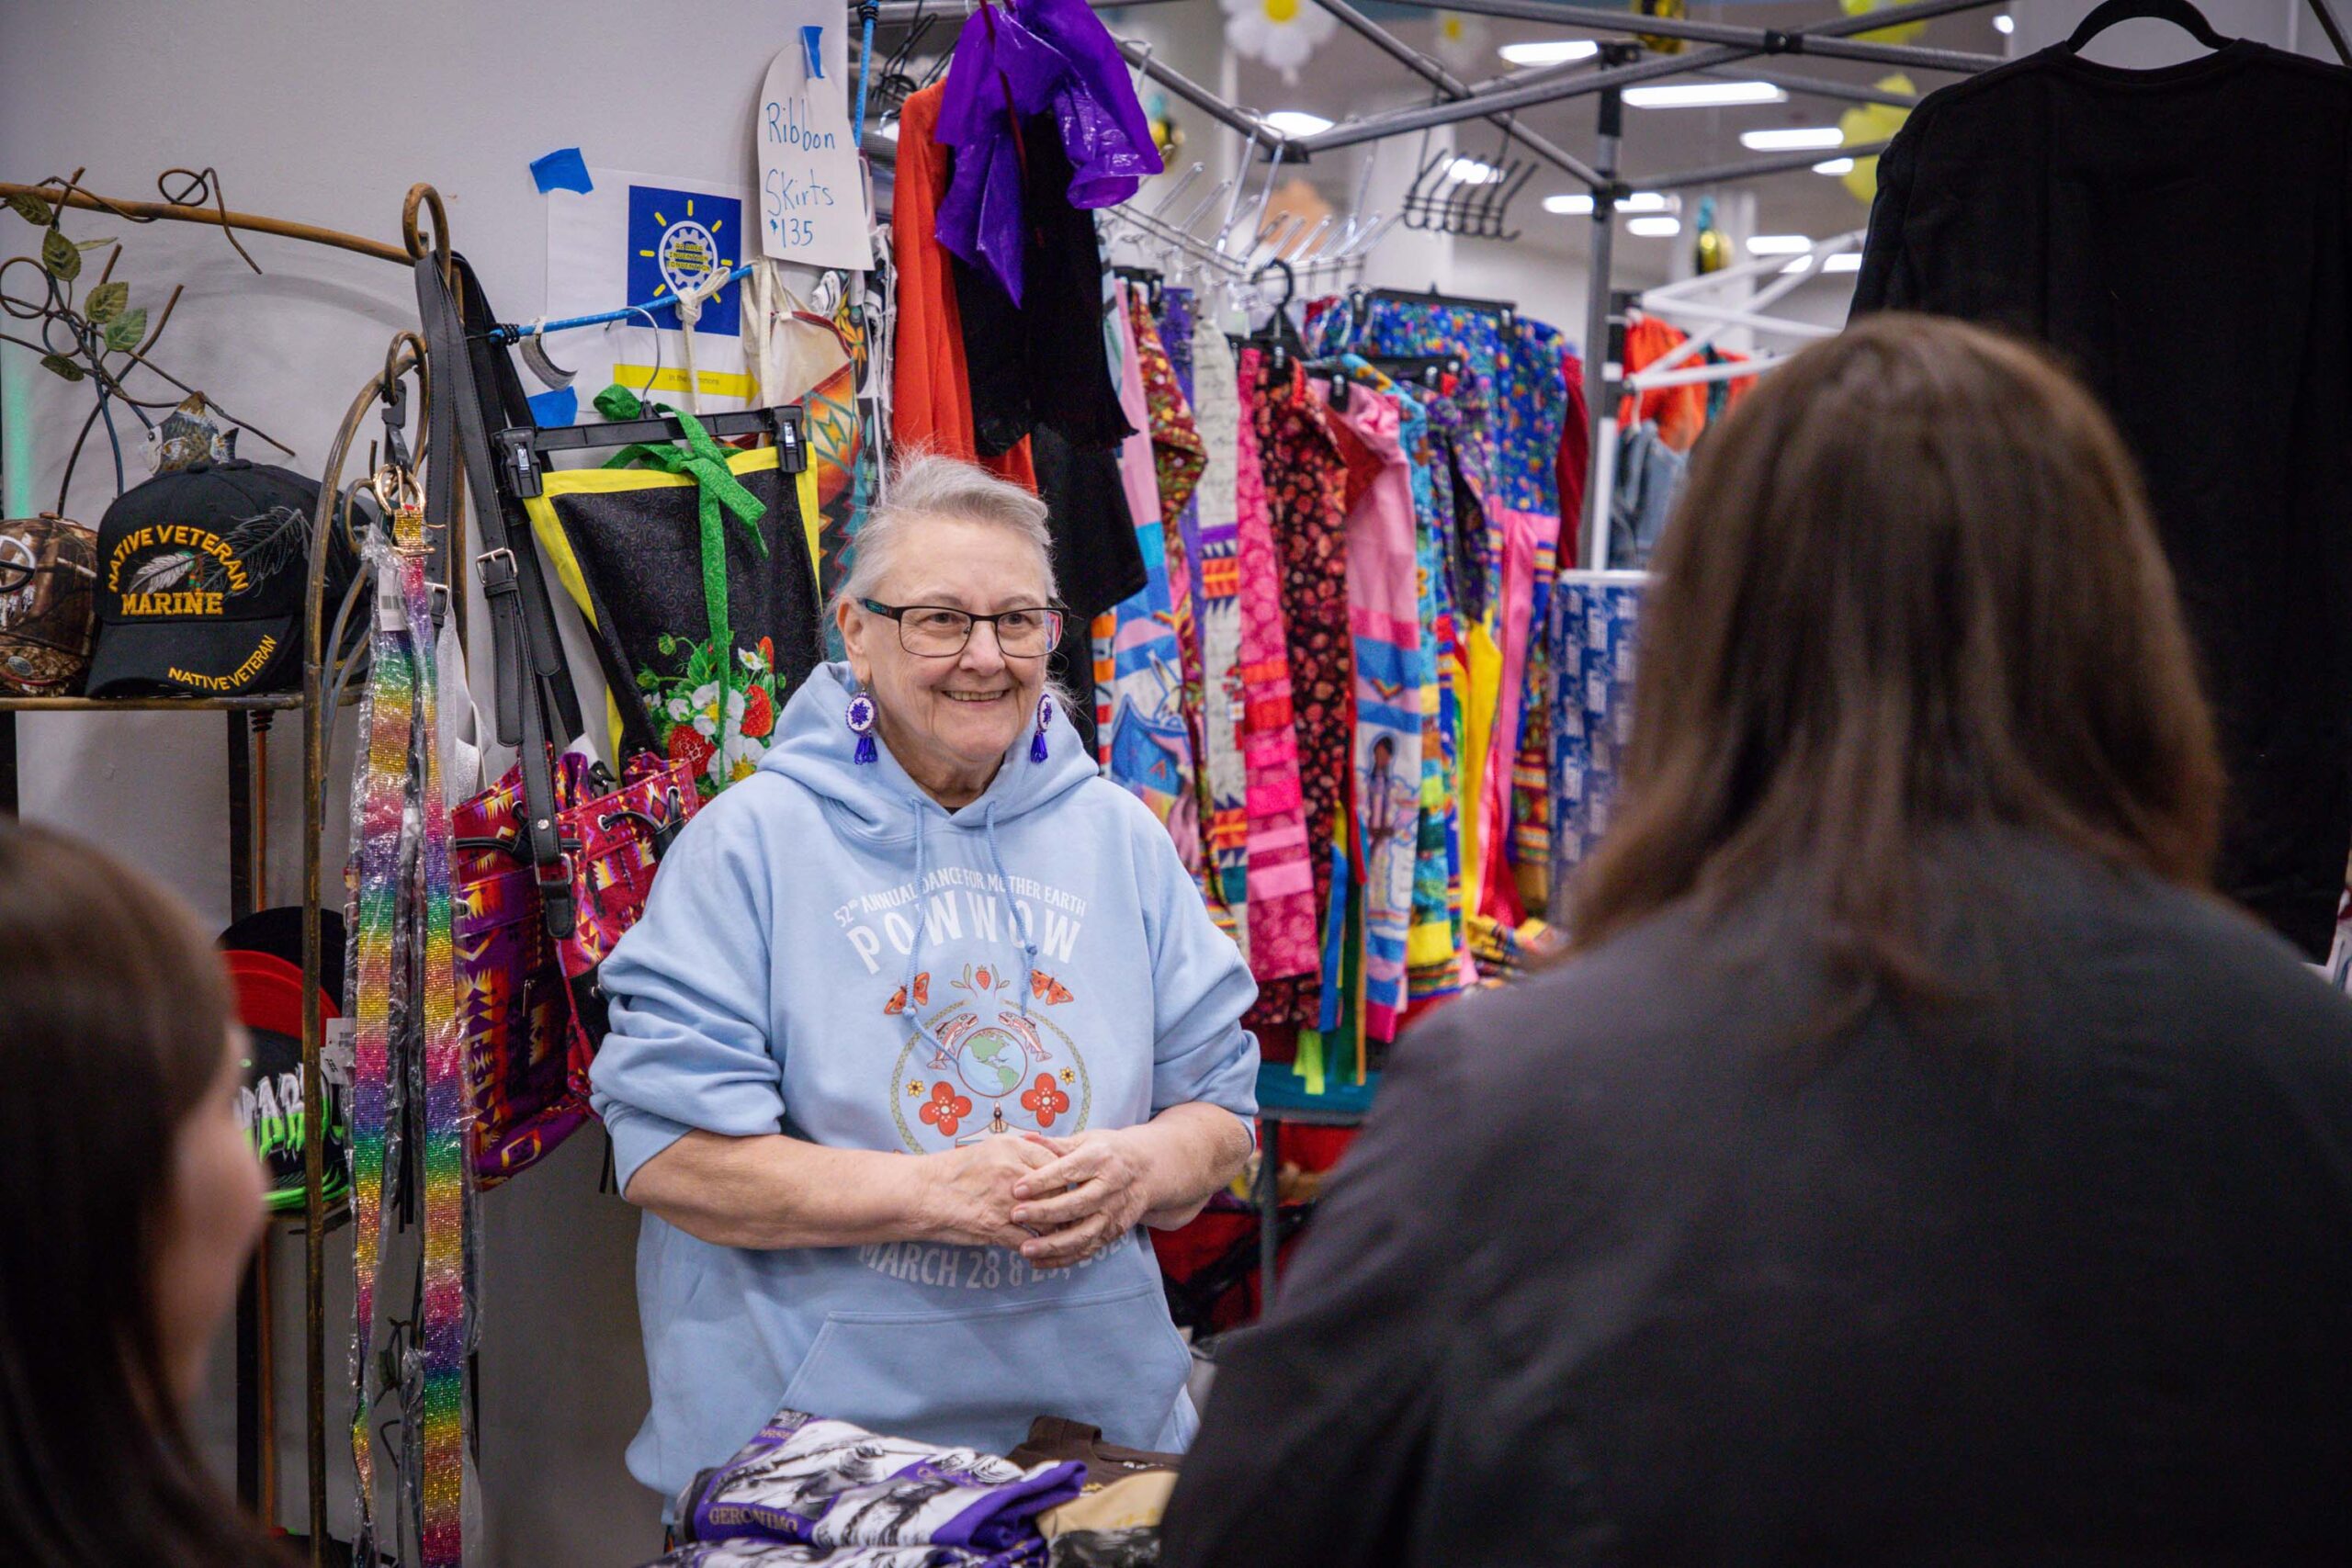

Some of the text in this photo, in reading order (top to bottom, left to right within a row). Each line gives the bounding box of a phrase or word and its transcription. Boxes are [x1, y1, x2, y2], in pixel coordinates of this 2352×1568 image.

[766, 96, 835, 152] Ribbon
[765, 168, 834, 217] Skirts
[769, 218, 814, 248] $135
[108, 525, 249, 592] NATIVE VETERAN
[121, 592, 223, 615] MARINE
[168, 635, 277, 691] NATIVE VETERAN
[860, 883, 918, 914] ANNUAL
[964, 870, 984, 890] FOR
[1044, 886, 1088, 918] EARTH
[858, 1241, 960, 1287] MARCH
[966, 1250, 1000, 1289] 28
[708, 1506, 798, 1532] GERONIMO
